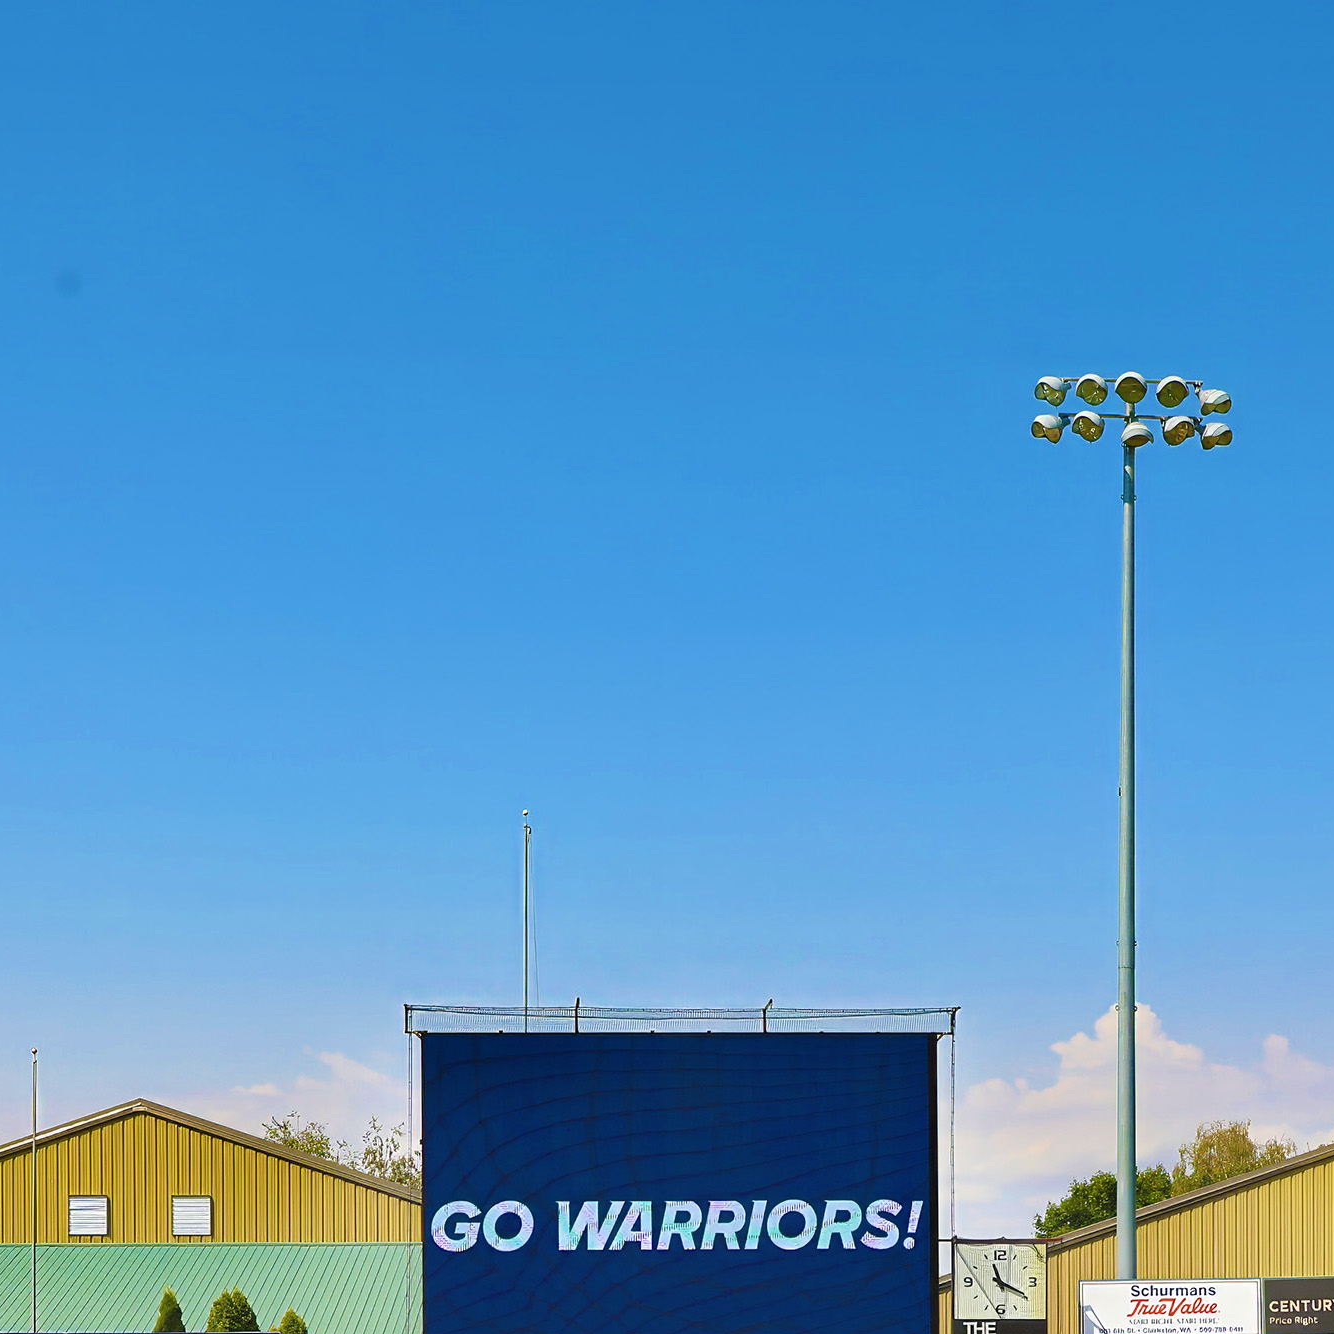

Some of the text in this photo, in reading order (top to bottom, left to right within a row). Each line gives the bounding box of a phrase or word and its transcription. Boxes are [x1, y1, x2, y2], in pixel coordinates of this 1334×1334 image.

[430, 1199, 924, 1253] GO WARRIORS!
[993, 1250, 1007, 1261] 12
[963, 1276, 974, 1288] 9
[1028, 1276, 1037, 1288] 3
[1130, 1284, 1217, 1298] Schurmans
[995, 1304, 1006, 1315] 6
[1269, 1315, 1319, 1327] Price Right
